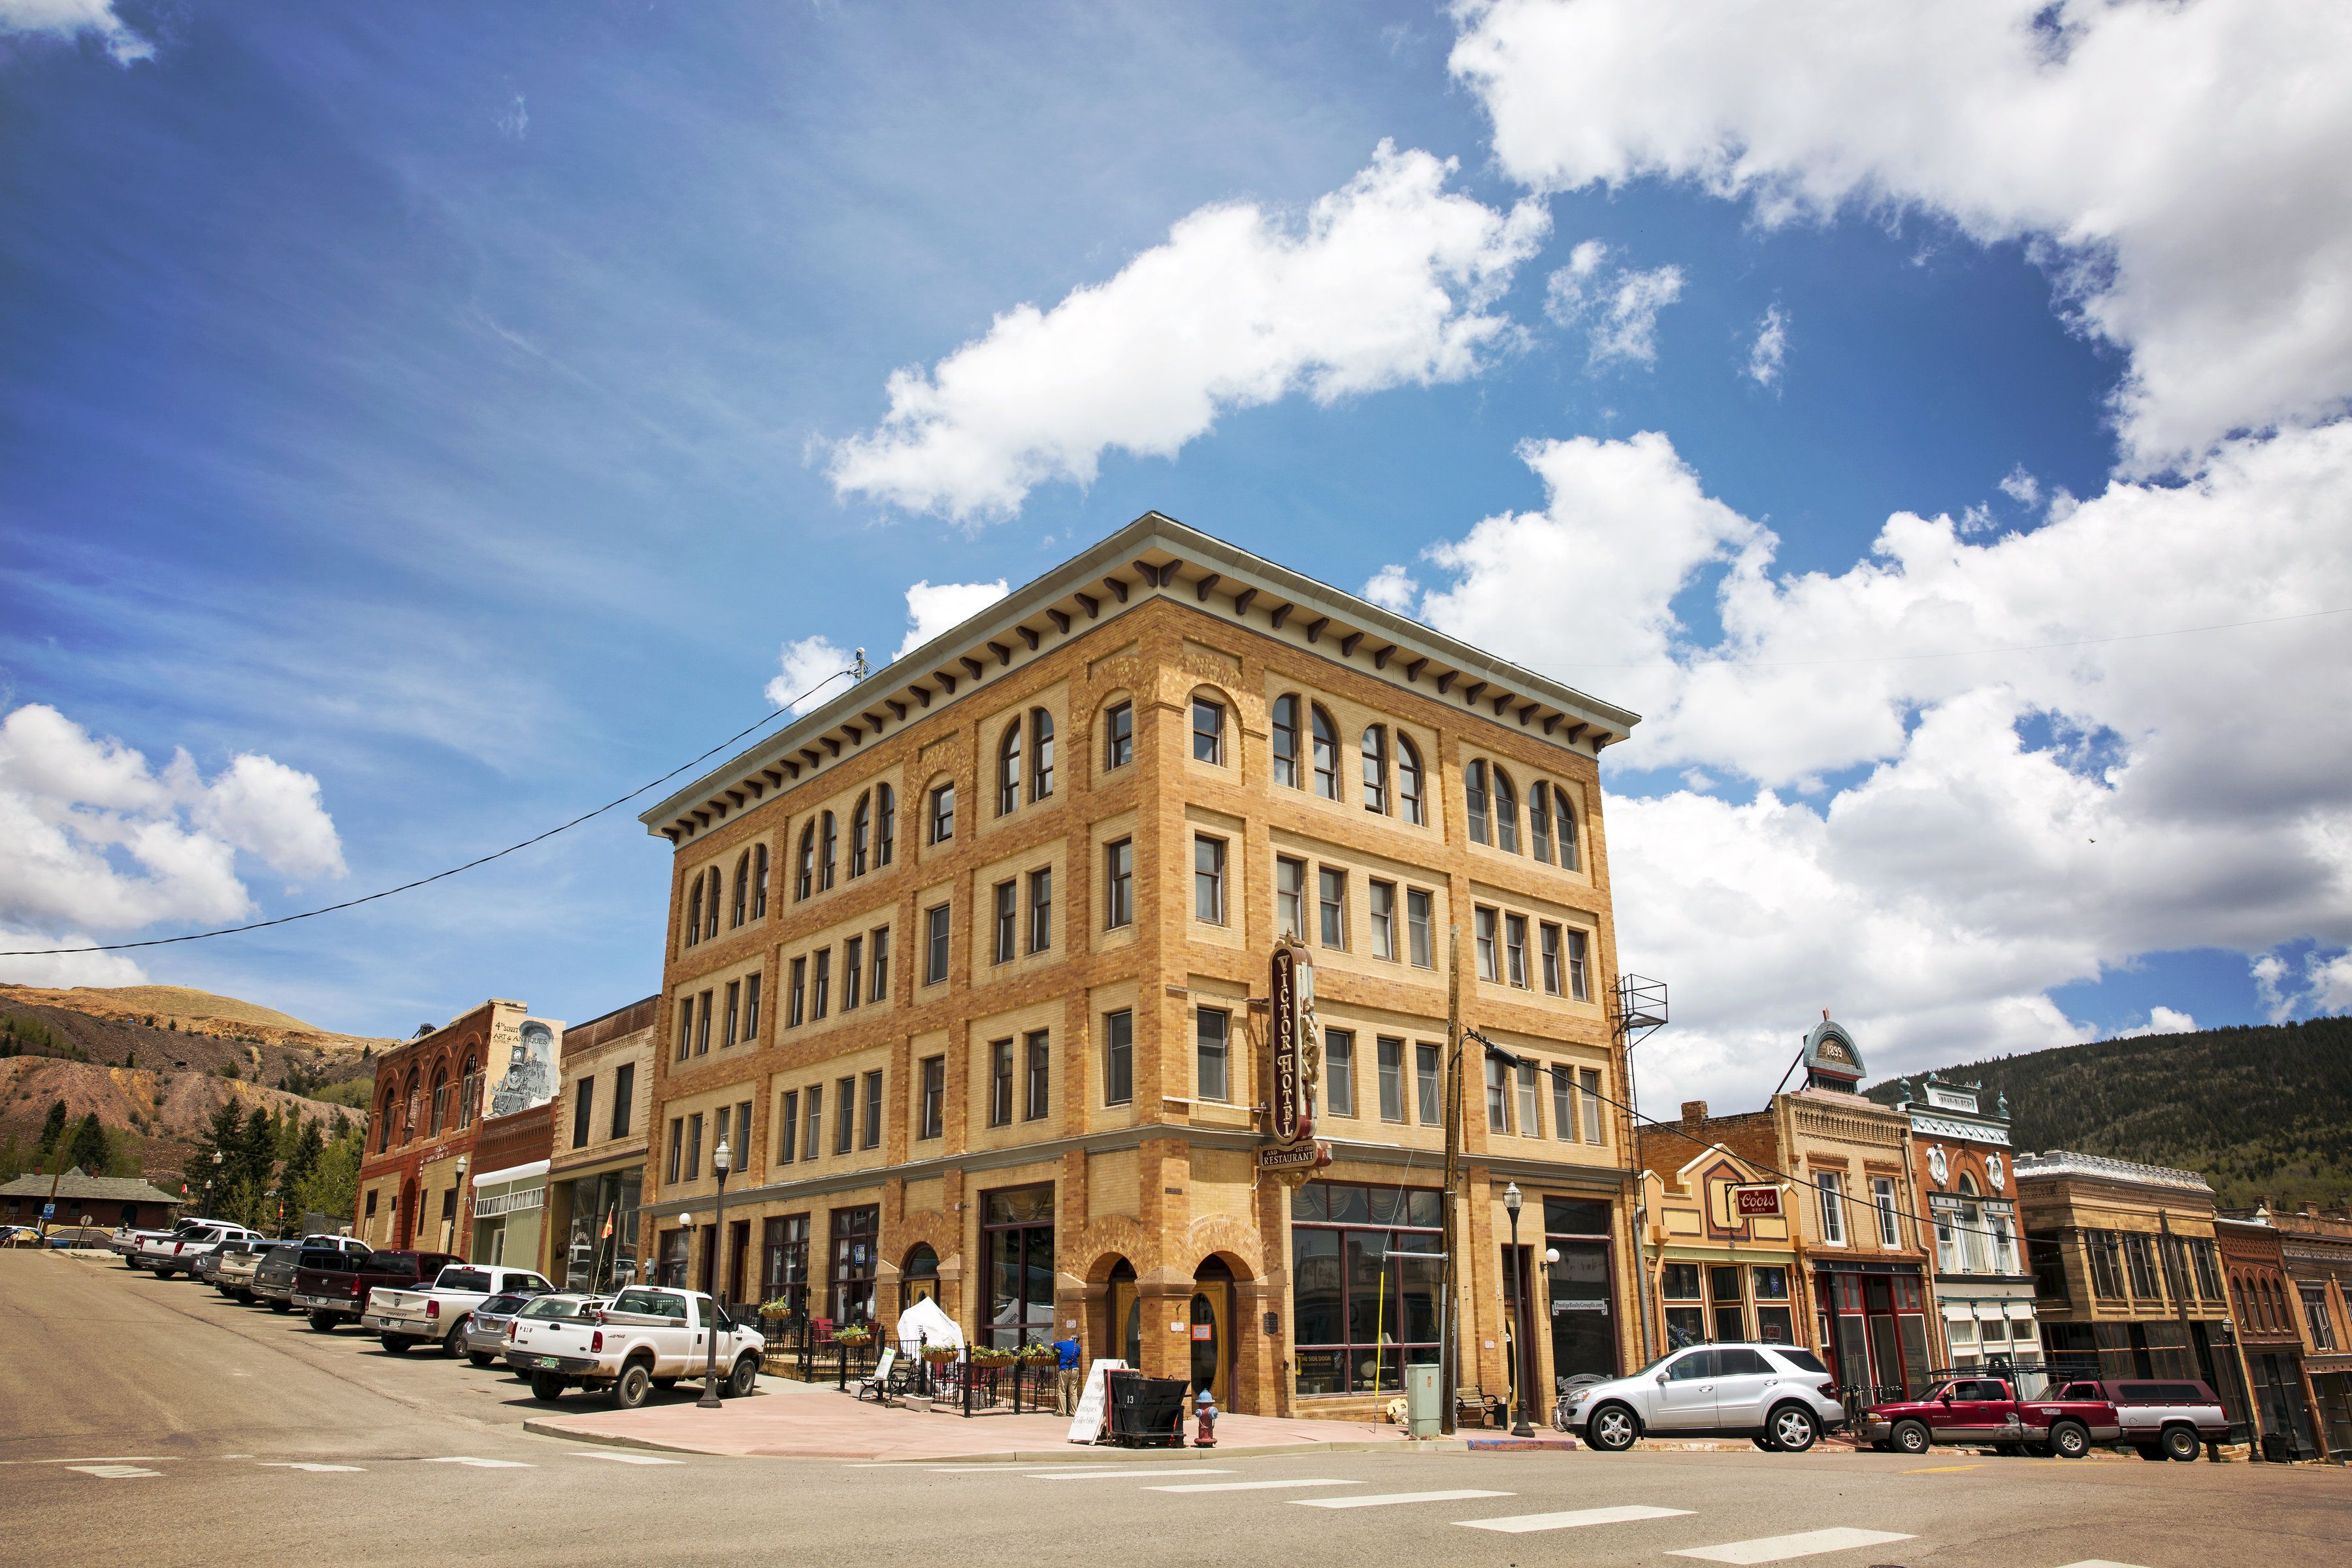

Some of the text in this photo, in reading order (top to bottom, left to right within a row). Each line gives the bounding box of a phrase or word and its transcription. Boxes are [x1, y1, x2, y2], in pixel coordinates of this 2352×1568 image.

[513, 1036, 547, 1045] ANTIQUES
[1277, 955, 1294, 1137] VICTOR HOTEL
[1827, 1045, 1842, 1058] 1899
[1264, 1152, 1313, 1165] RESTAURANT
[1740, 1194, 1775, 1207] Coors
[1560, 1375, 1584, 1388] RESIDENTIAL
[1077, 1405, 1097, 1414] Antiques
[1073, 1416, 1098, 1425] Collectibles
